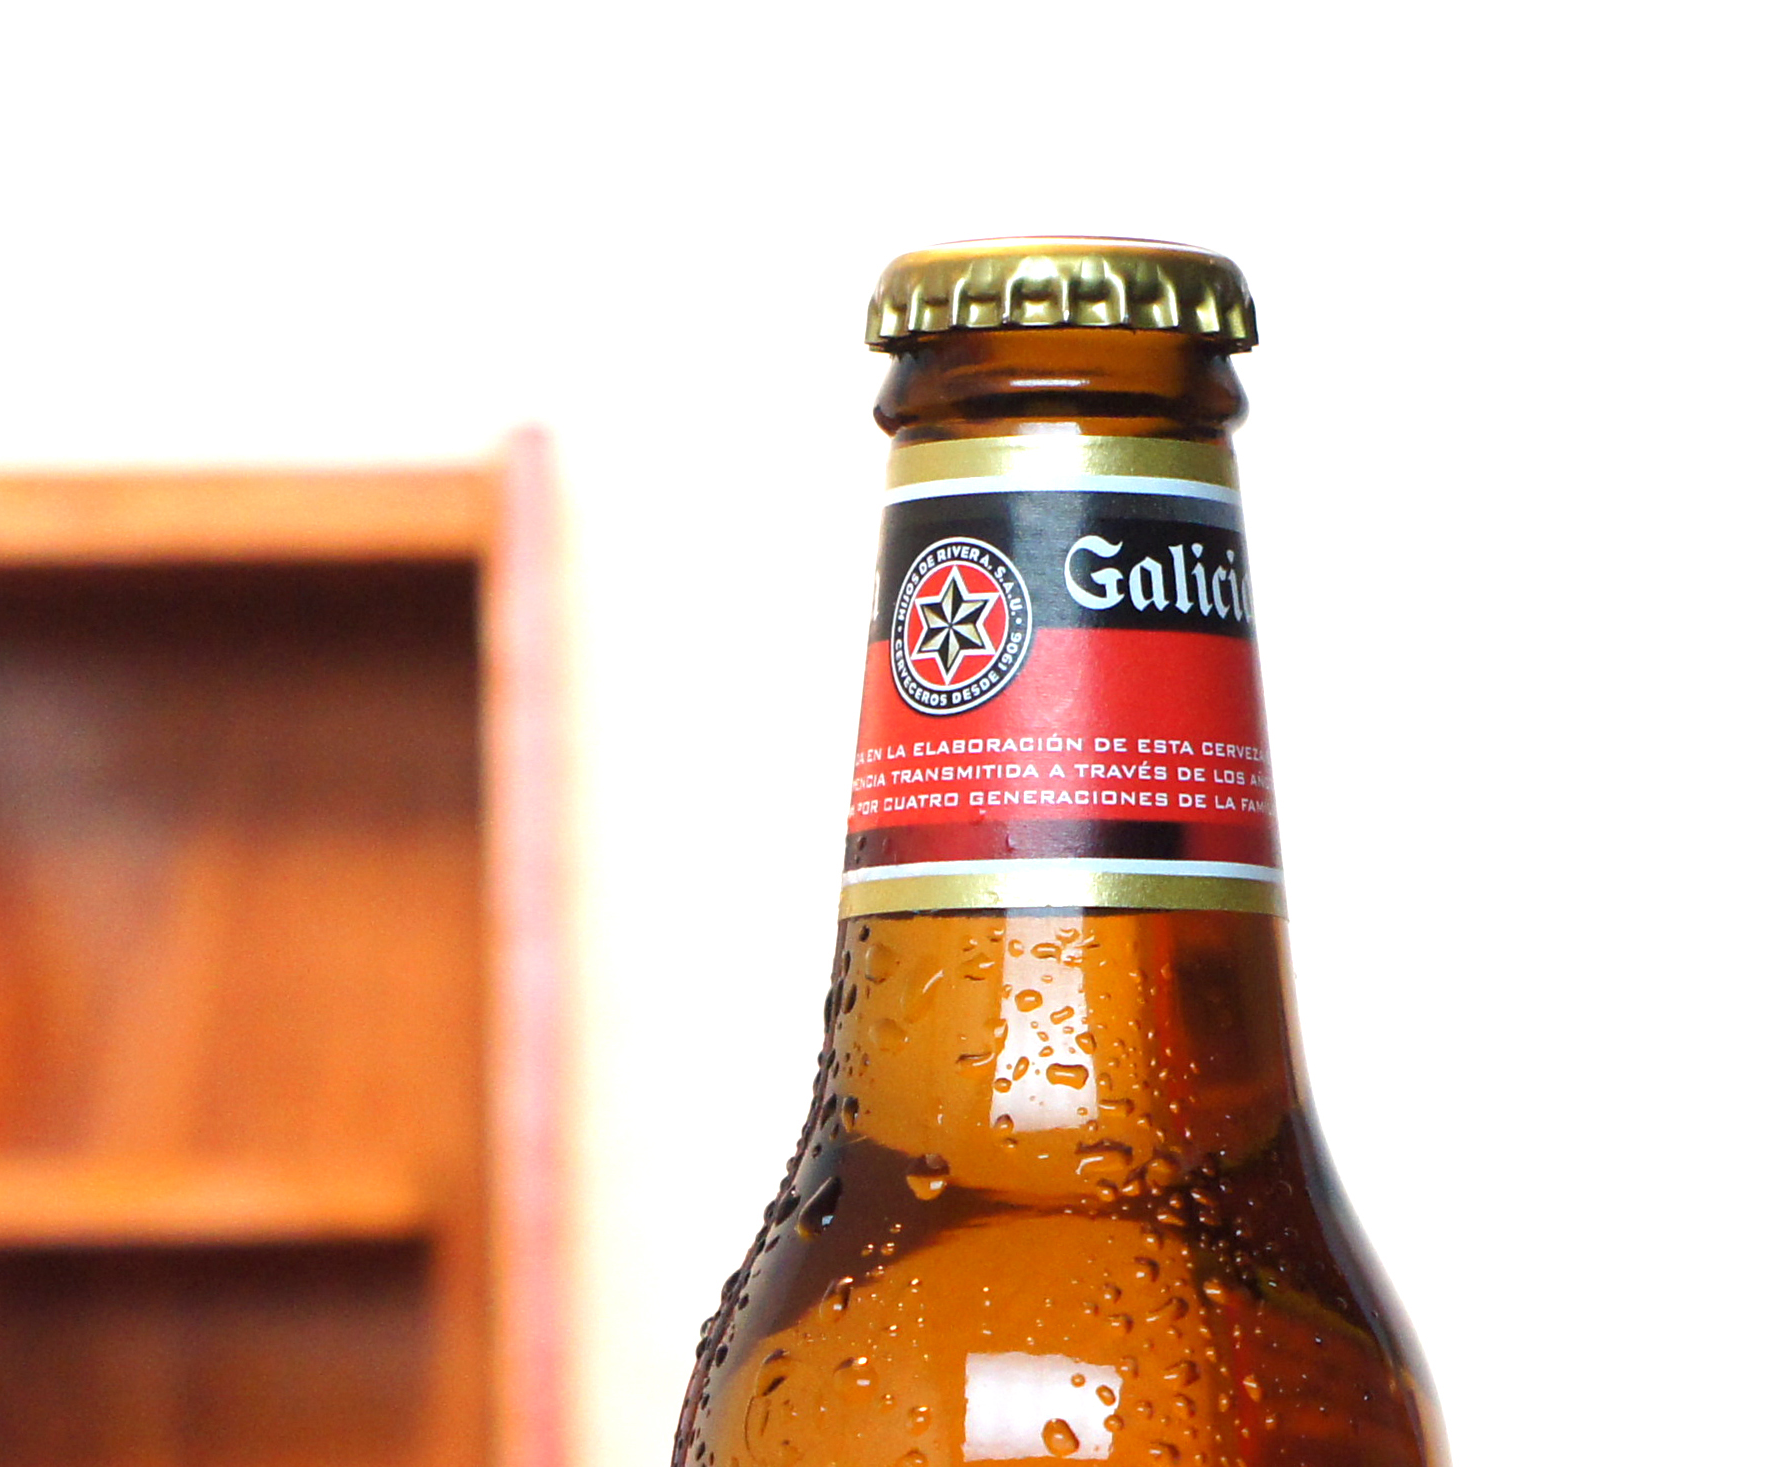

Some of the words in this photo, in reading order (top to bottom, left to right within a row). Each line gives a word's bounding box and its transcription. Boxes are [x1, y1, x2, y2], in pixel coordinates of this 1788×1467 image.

[898, 573, 919, 621] HIJOS
[918, 555, 936, 575] DE
[994, 565, 1023, 616] S.A.U.
[895, 639, 947, 706] CERVECEROS
[952, 670, 999, 705] DESDE
[998, 632, 1022, 671] 1906
[867, 747, 882, 764] EN
[887, 744, 906, 760] LA
[913, 733, 1082, 757] ELABORACIÓN
[1094, 737, 1127, 752] DE
[1138, 738, 1194, 755] ESTA
[891, 763, 1039, 785] TRANSMITIDA
[1049, 763, 1066, 778] A
[1074, 761, 1167, 780] TRAVÉS
[1177, 766, 1206, 782] DE
[1213, 769, 1246, 785] LOS
[884, 792, 959, 812] CUATRO
[969, 790, 1168, 807] GENERACIONES
[1178, 793, 1207, 808] DE
[1214, 795, 1236, 811] LA
